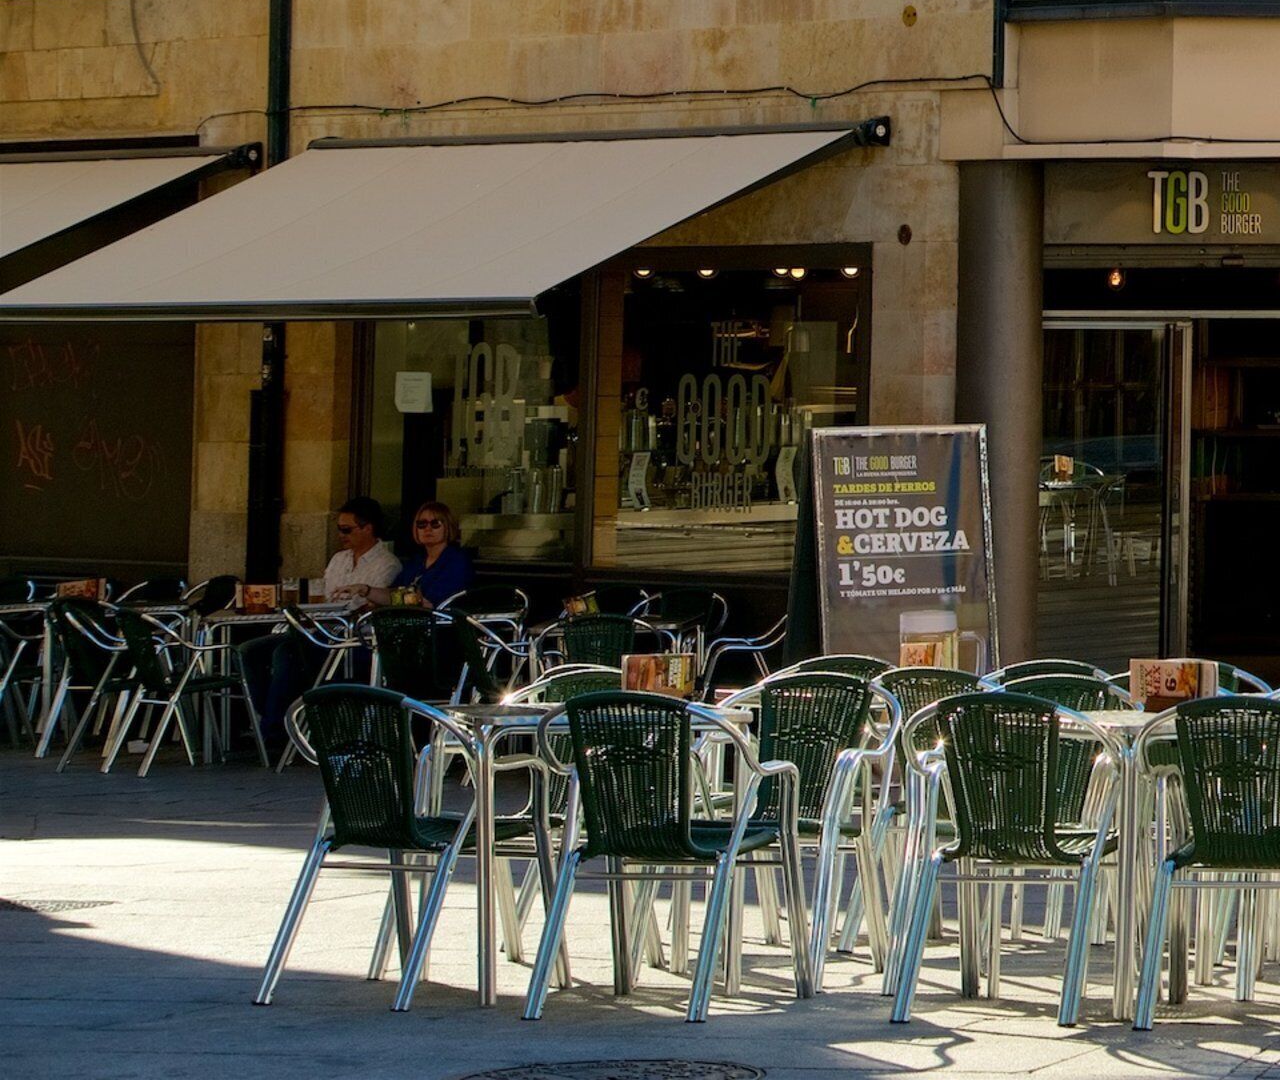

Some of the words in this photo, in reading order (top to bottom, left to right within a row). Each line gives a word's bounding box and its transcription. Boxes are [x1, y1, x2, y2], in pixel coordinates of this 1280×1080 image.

[1221, 171, 1240, 191] THE
[1147, 170, 1210, 234] TGB
[1221, 192, 1250, 213] GOOD
[1221, 213, 1262, 234] BURGER
[676, 373, 772, 465] GOOD
[833, 457, 850, 476] TGB
[855, 456, 868, 470] THE
[869, 456, 889, 470] GOOD
[890, 455, 917, 469] BURGER
[833, 483, 877, 493] TARDES
[878, 483, 893, 492] DE
[894, 482, 936, 492] PERROS
[834, 508, 890, 529] HOT
[894, 506, 948, 528] DOG
